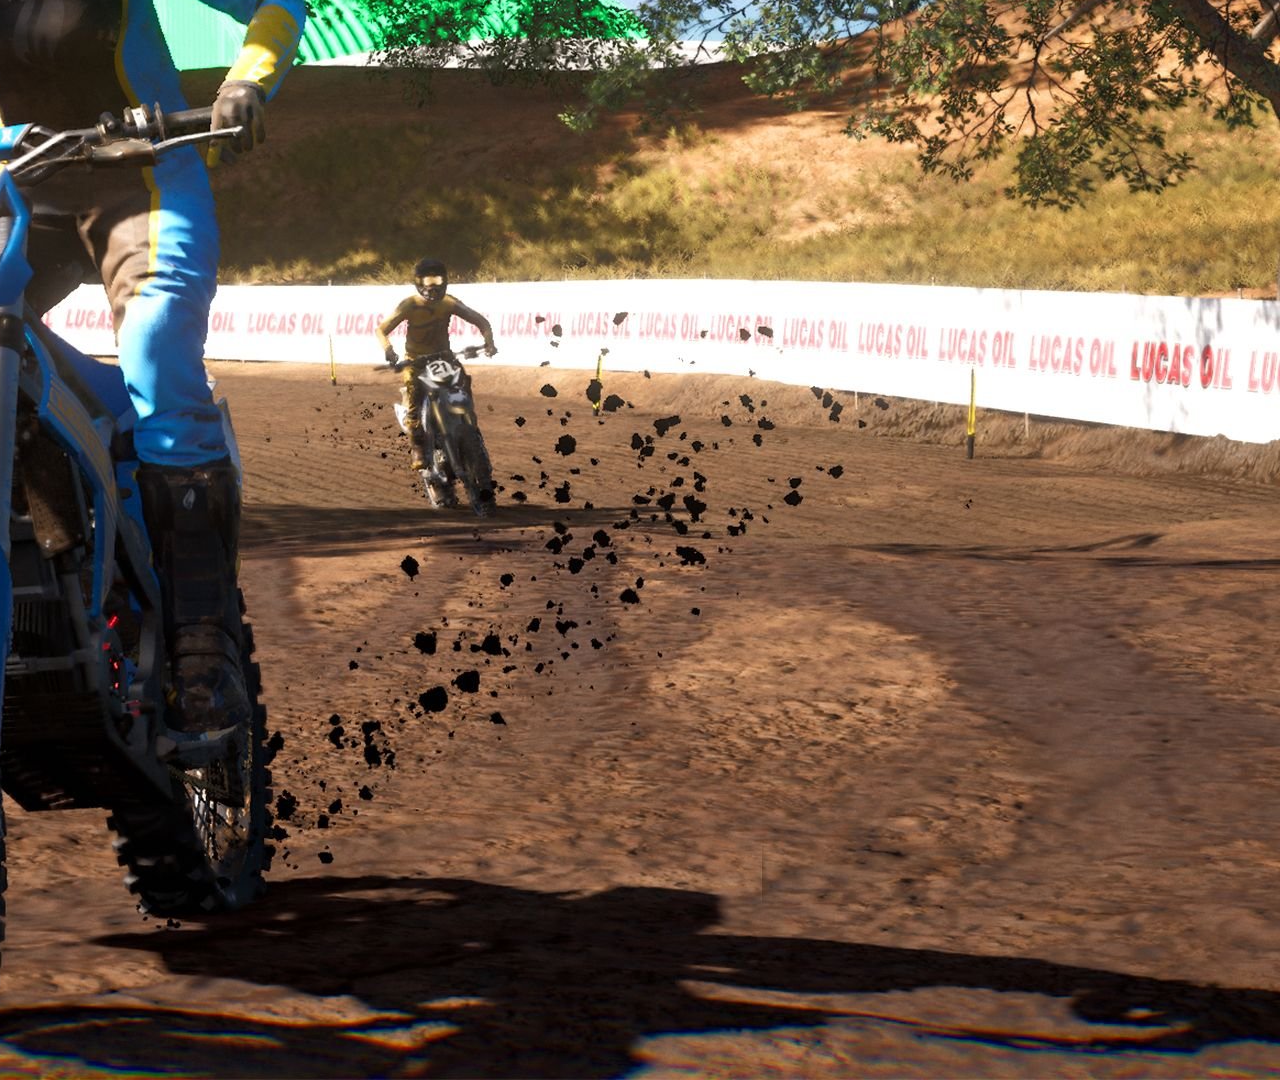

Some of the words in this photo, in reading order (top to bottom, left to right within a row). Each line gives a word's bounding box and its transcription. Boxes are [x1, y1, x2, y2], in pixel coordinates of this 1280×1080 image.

[211, 311, 235, 333] OIL
[247, 312, 297, 334] LUCAS
[301, 313, 324, 335] OIL
[499, 312, 537, 337] LUCAS
[571, 312, 609, 336] LUCAS
[639, 312, 677, 339] LUCAS
[680, 313, 700, 340] OIL
[782, 318, 824, 348] LUCAS
[828, 320, 849, 350] OIL
[857, 322, 903, 358] LUCAS
[906, 326, 929, 360] OIL
[937, 327, 987, 366] LUCAS
[991, 330, 1017, 368] OIL
[430, 362, 447, 376] 21
[1029, 335, 1083, 375] LUCAS
[1088, 338, 1117, 378] OIL
[1130, 340, 1195, 387] LUCAS
[1198, 343, 1233, 390] OIL
